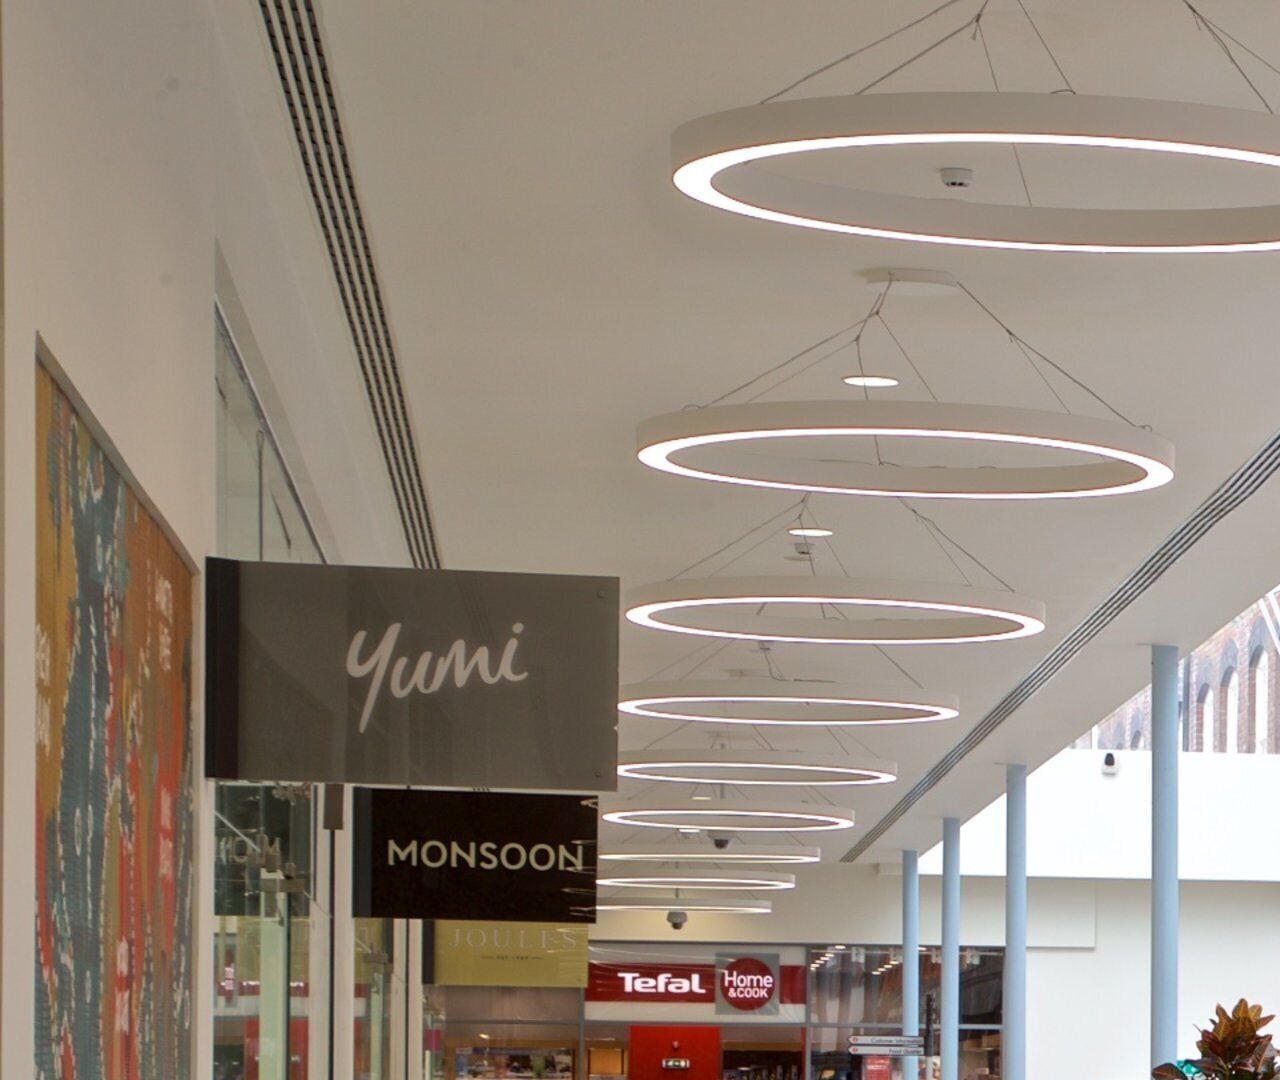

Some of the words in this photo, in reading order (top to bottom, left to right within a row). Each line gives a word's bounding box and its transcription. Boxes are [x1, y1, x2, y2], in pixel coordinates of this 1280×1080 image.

[346, 622, 528, 734] Yumi
[387, 839, 584, 871] MONSOON
[450, 928, 577, 949] JOULES
[617, 972, 707, 994] Tefal
[724, 970, 774, 988] Home
[728, 987, 768, 998] &COOK
